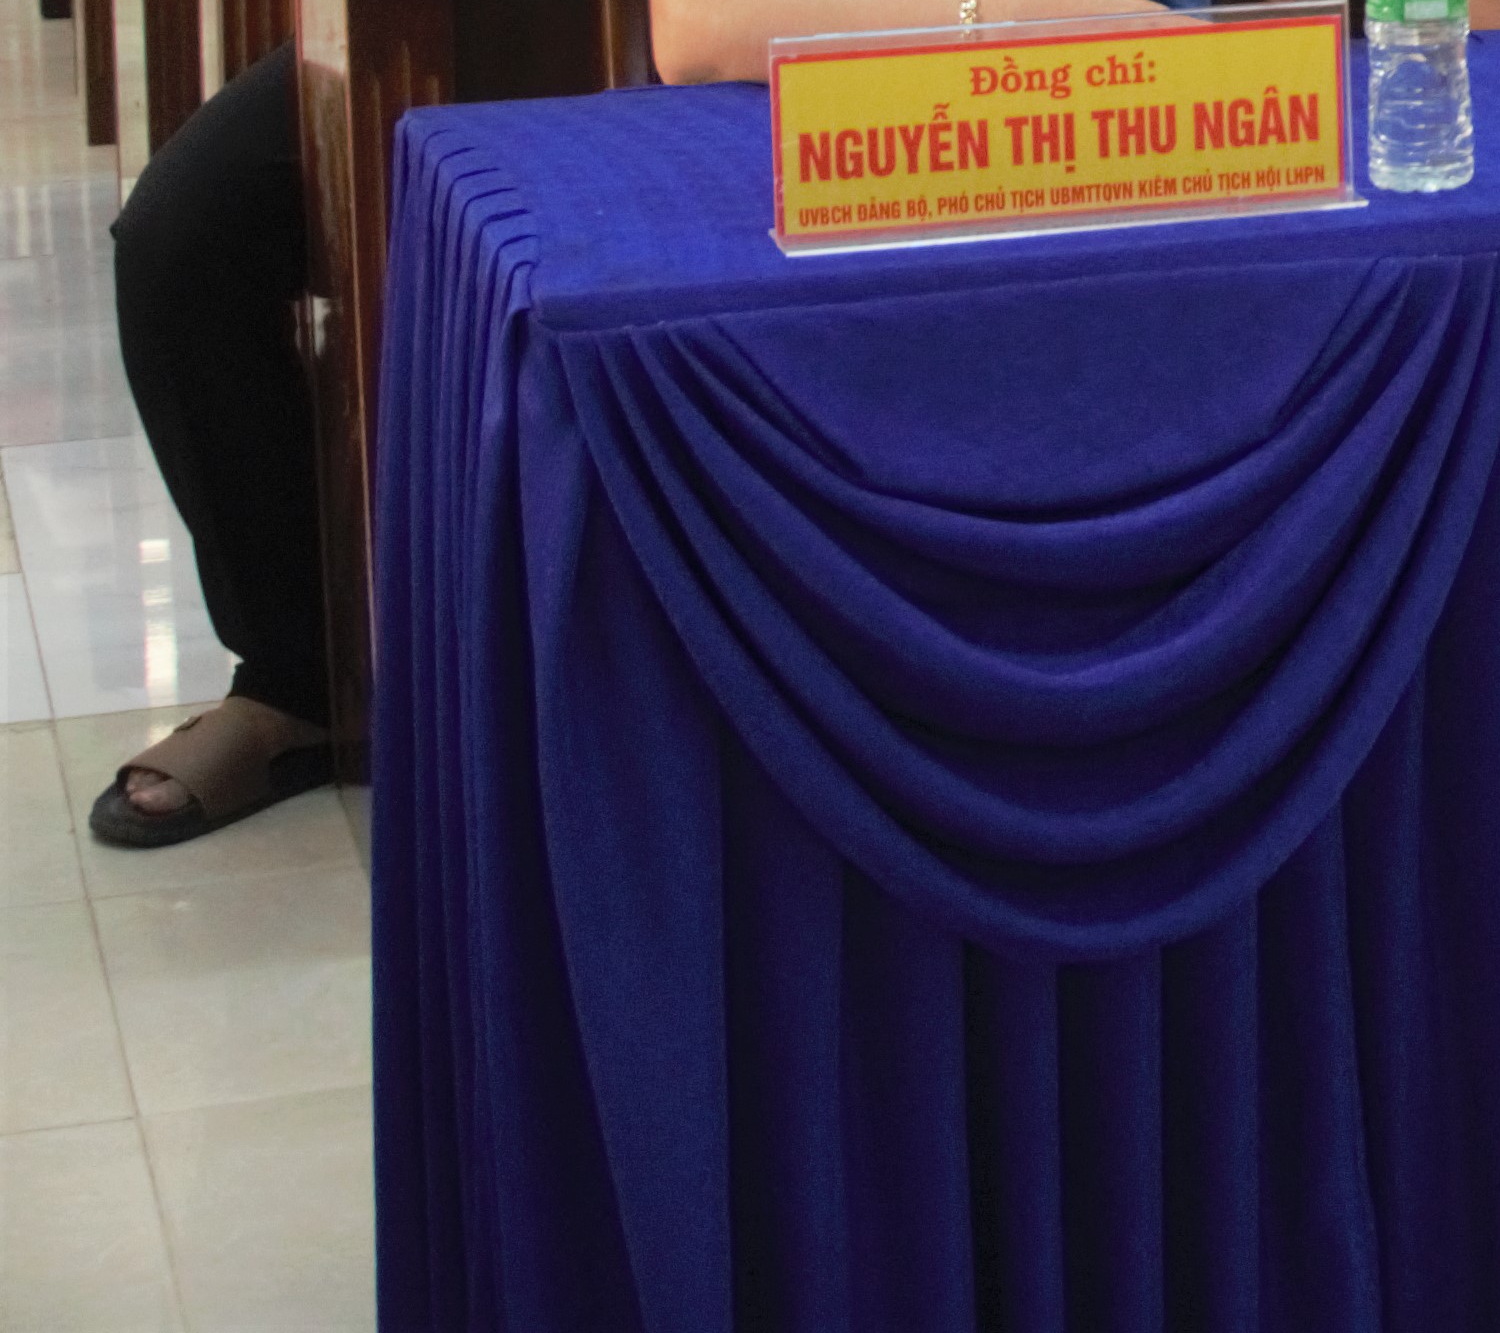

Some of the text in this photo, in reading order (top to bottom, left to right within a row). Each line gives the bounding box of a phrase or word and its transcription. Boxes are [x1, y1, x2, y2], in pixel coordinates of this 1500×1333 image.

[970, 52, 1156, 99] Đồng chí:
[797, 84, 1321, 185] NGUYỄN THỊ THU NGÂN
